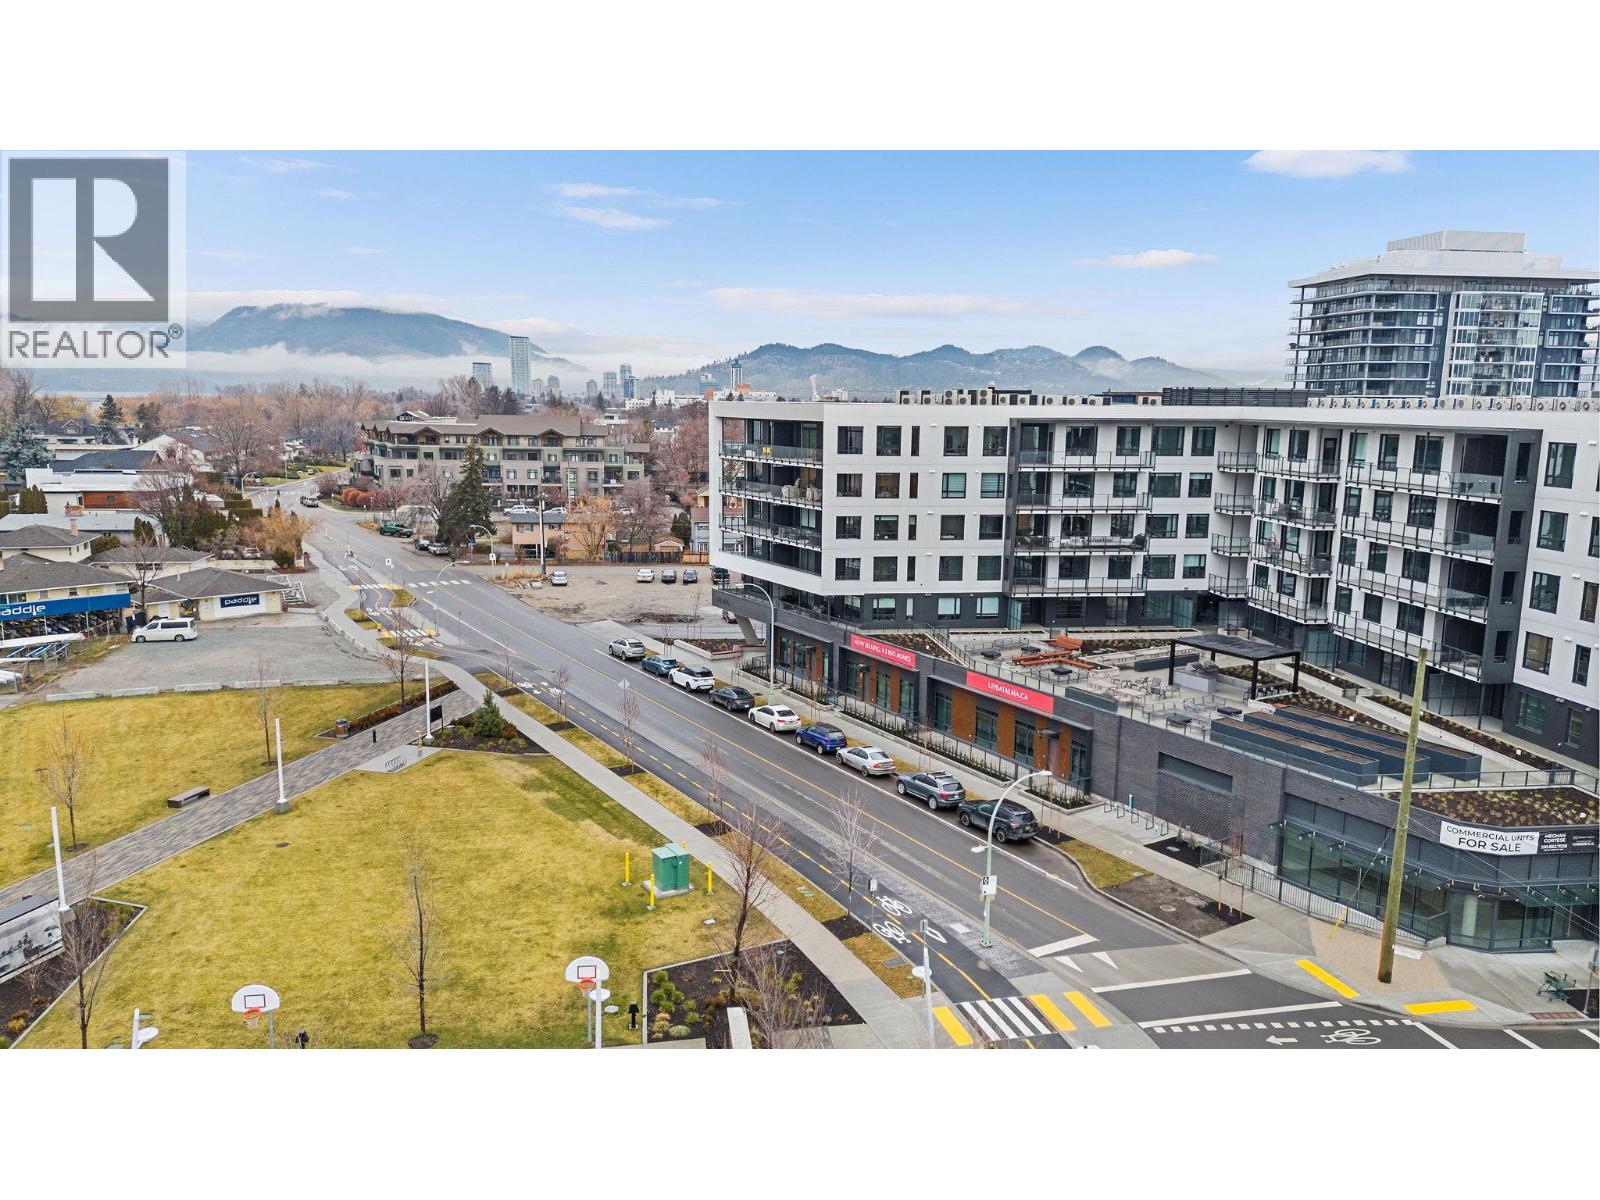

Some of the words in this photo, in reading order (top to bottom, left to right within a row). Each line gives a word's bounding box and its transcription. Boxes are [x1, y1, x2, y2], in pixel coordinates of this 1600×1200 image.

[224, 597, 257, 605] paddle
[0, 604, 46, 616] addle
[1446, 825, 1510, 842] COMMERCIAL
[1458, 837, 1487, 850] FOR
[1491, 842, 1521, 853] SALE
